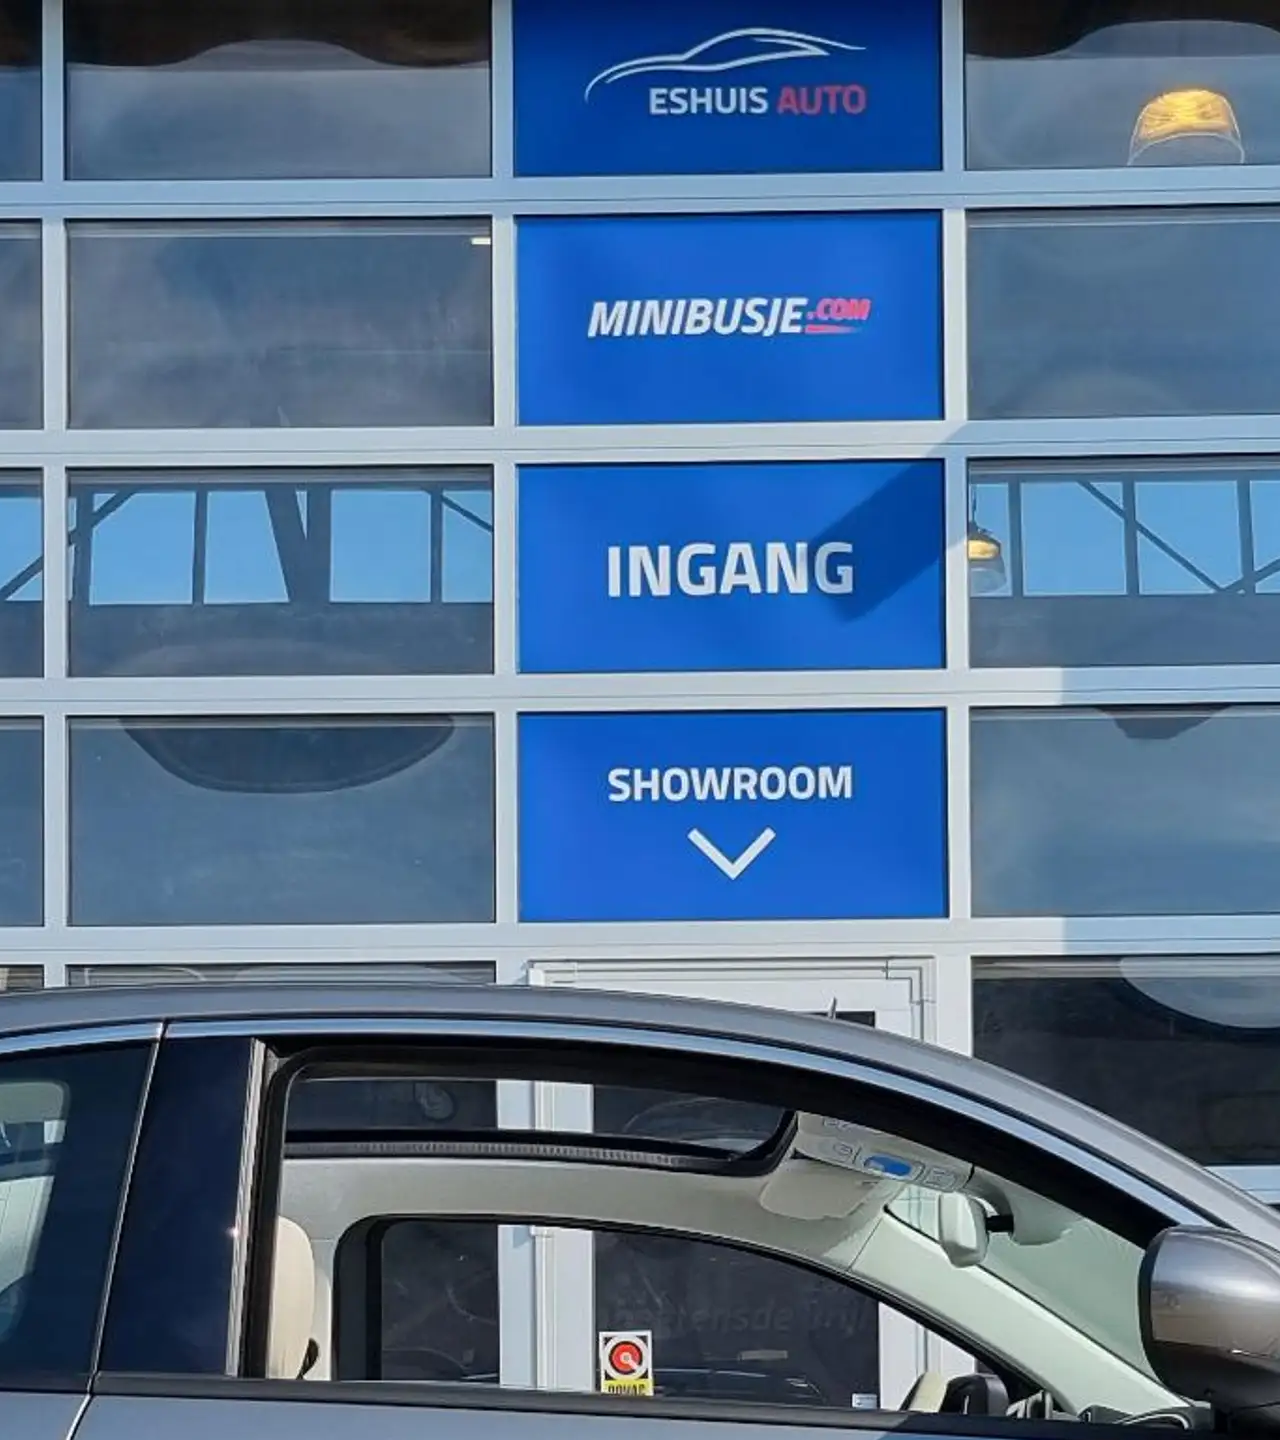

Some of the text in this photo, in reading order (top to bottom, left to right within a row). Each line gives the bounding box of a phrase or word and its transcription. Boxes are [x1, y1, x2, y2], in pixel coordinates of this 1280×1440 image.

[649, 84, 867, 115] ESHUIS AUTO
[587, 297, 872, 338] MINIBUSJE.COM
[607, 541, 854, 598] INGANG
[607, 765, 853, 803] SHOWROOM
